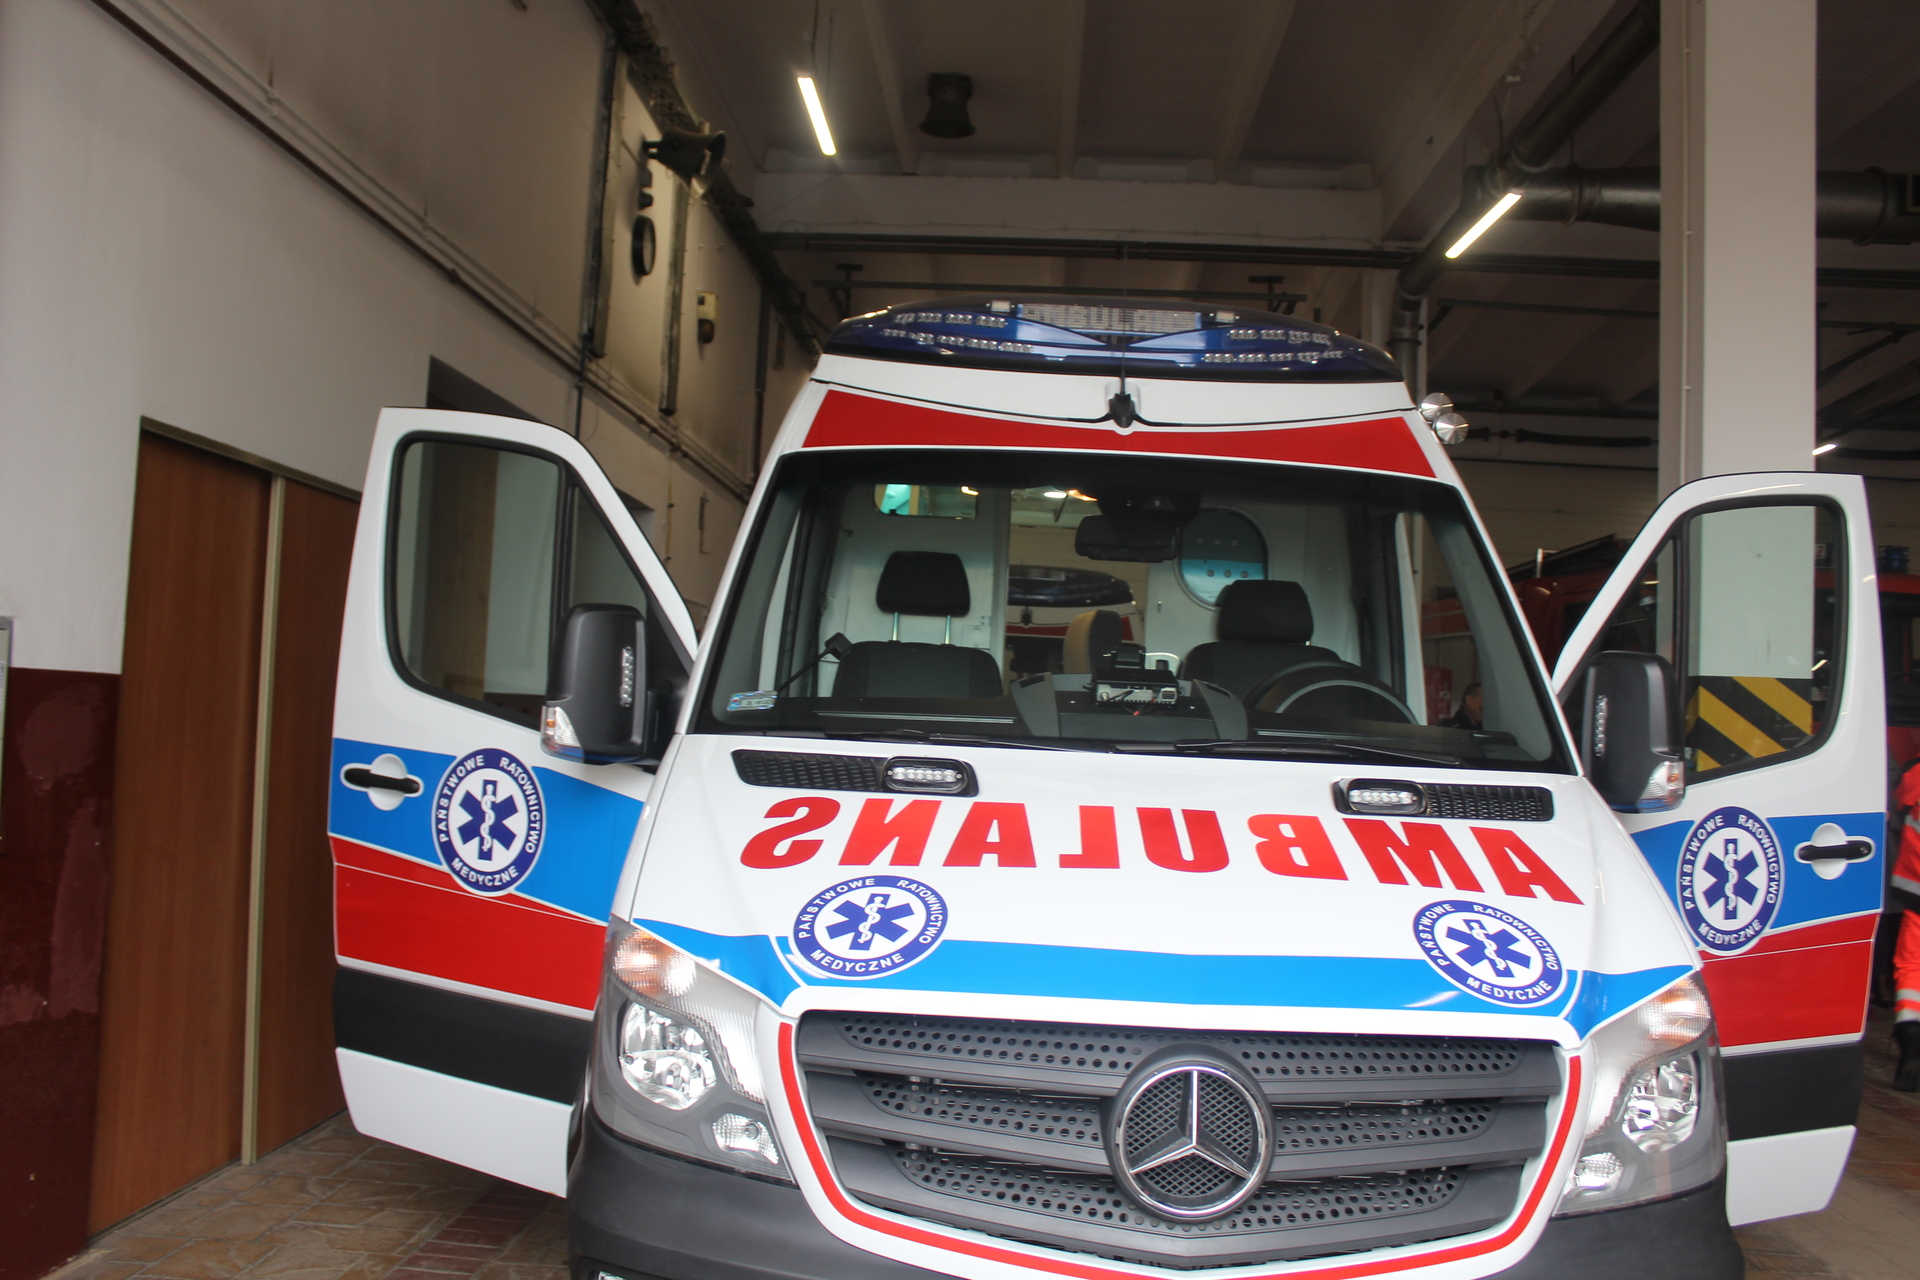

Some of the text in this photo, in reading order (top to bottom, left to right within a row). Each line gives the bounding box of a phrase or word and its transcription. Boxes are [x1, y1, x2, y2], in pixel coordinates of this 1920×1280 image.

[437, 755, 541, 854] PAŃSTWOWE RATOWNICTWO
[451, 857, 519, 887] MEDYCZNE
[1680, 814, 1780, 910] PAŃSTWOWE RATOWNICTWO
[798, 878, 944, 944] PAŃSTWOWE RATOWNICTWO
[1697, 918, 1763, 945] MEDYCZNE
[810, 949, 905, 973] MEDYCZNE
[1418, 903, 1559, 971] PAŃSTWOWE RATOWNICTWO
[1466, 976, 1553, 1001] MEDYCZNE
